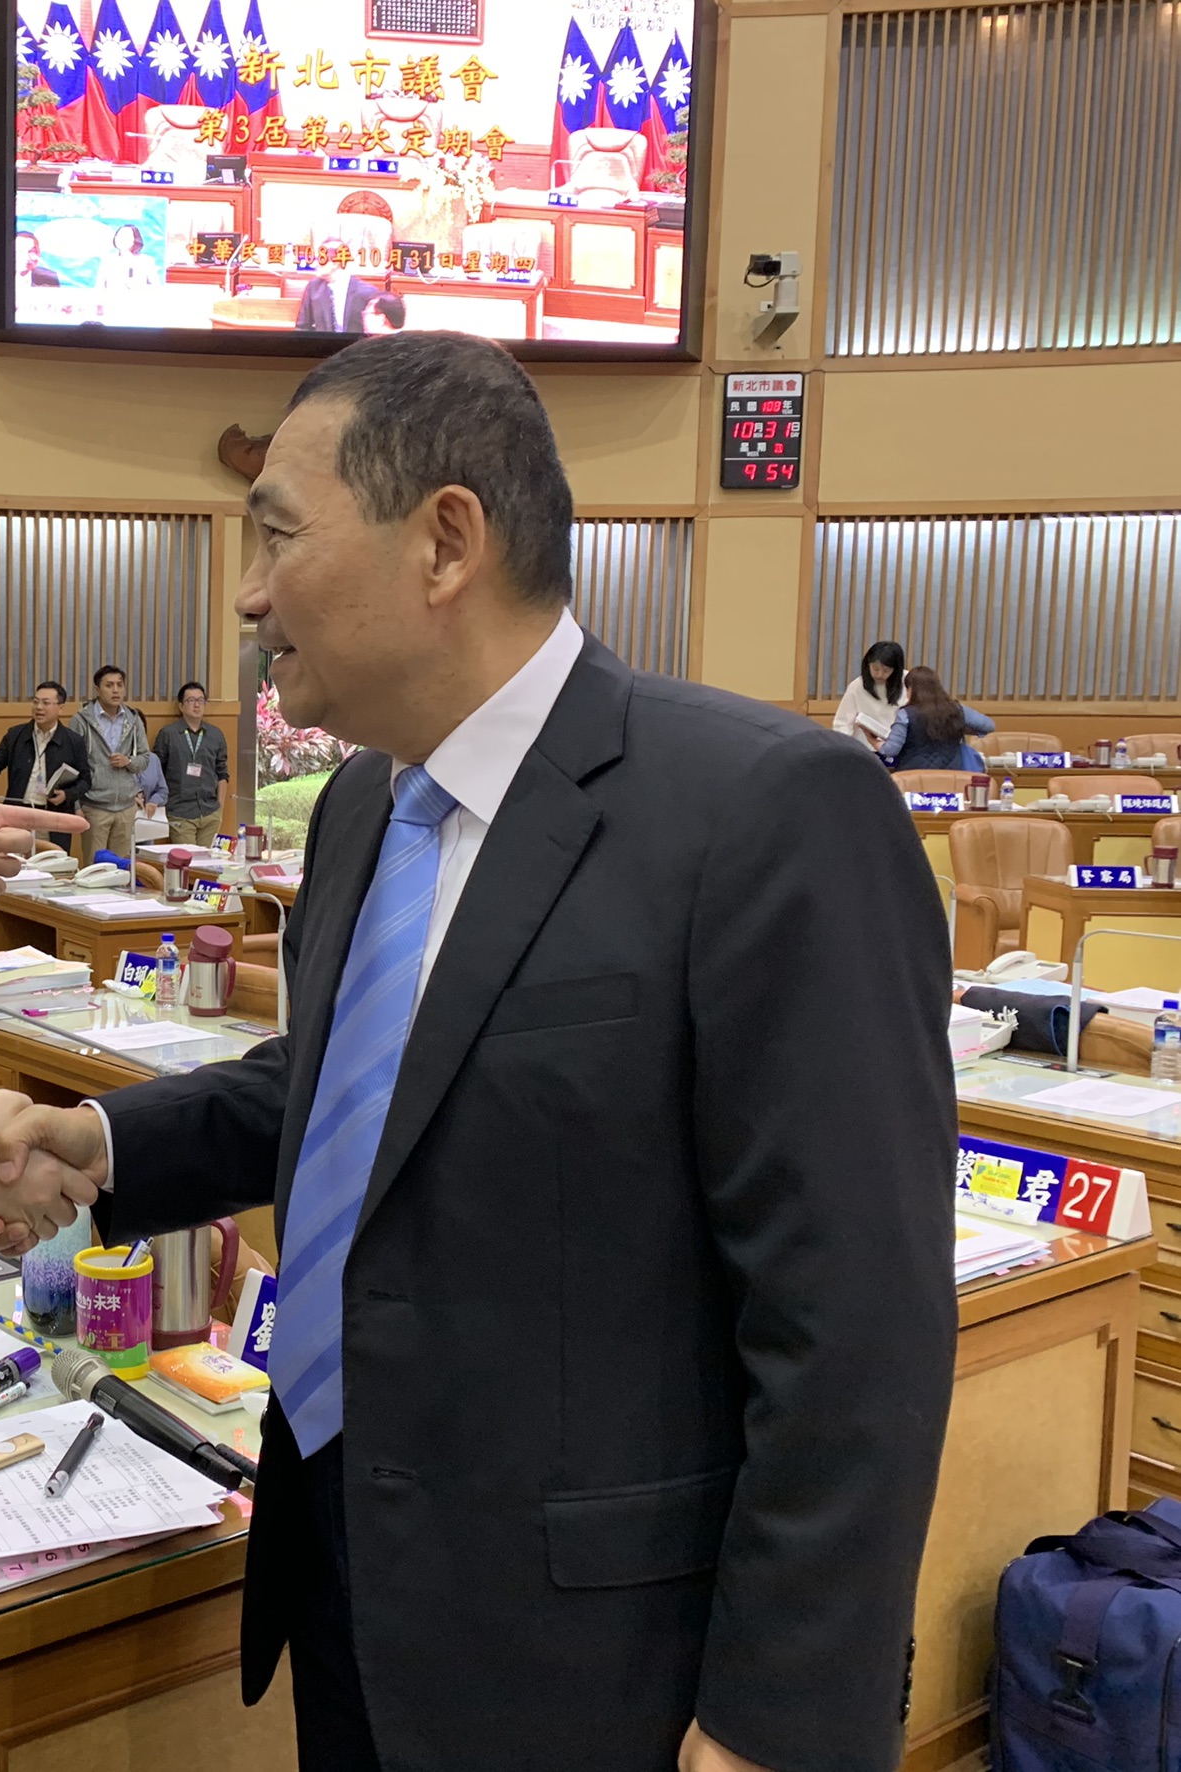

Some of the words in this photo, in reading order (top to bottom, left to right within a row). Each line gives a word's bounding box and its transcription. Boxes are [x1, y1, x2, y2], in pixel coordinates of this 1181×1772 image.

[238, 45, 499, 103] 新北市議會
[193, 107, 516, 161] 第3屆第2次定期會
[185, 235, 536, 274] 中華民國108年10月31日星期四
[732, 380, 797, 392] 新北市議會
[1025, 755, 1063, 766] 水利局
[1081, 869, 1133, 884] 警察局
[956, 1148, 1060, 1207] 蔡君
[1062, 1171, 1113, 1223] 27
